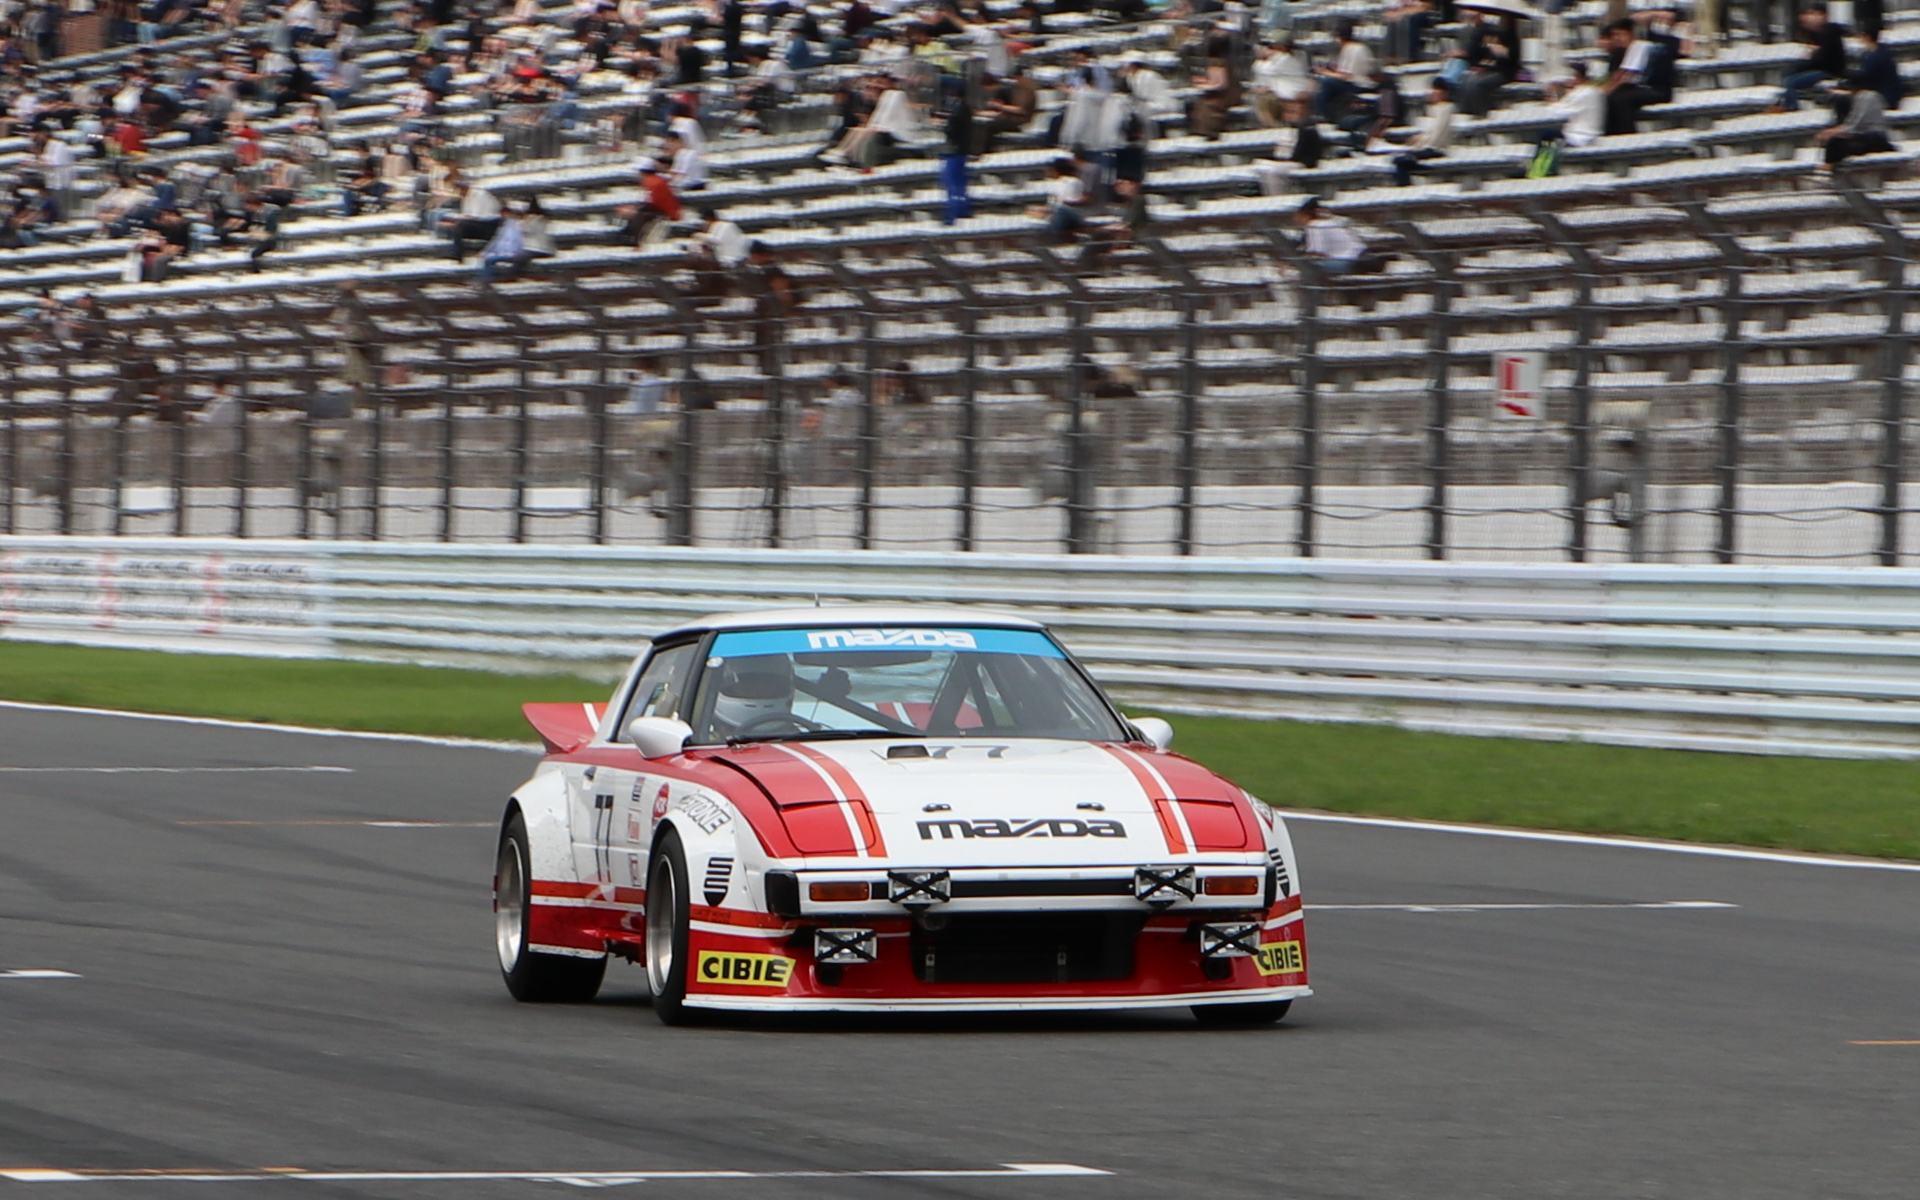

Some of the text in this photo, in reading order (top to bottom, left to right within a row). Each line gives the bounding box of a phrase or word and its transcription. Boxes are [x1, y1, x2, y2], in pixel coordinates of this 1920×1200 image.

[807, 629, 977, 649] mazda
[916, 819, 1127, 840] mazda
[702, 957, 789, 982] CIBIE
[1257, 945, 1300, 971] CIBIE
